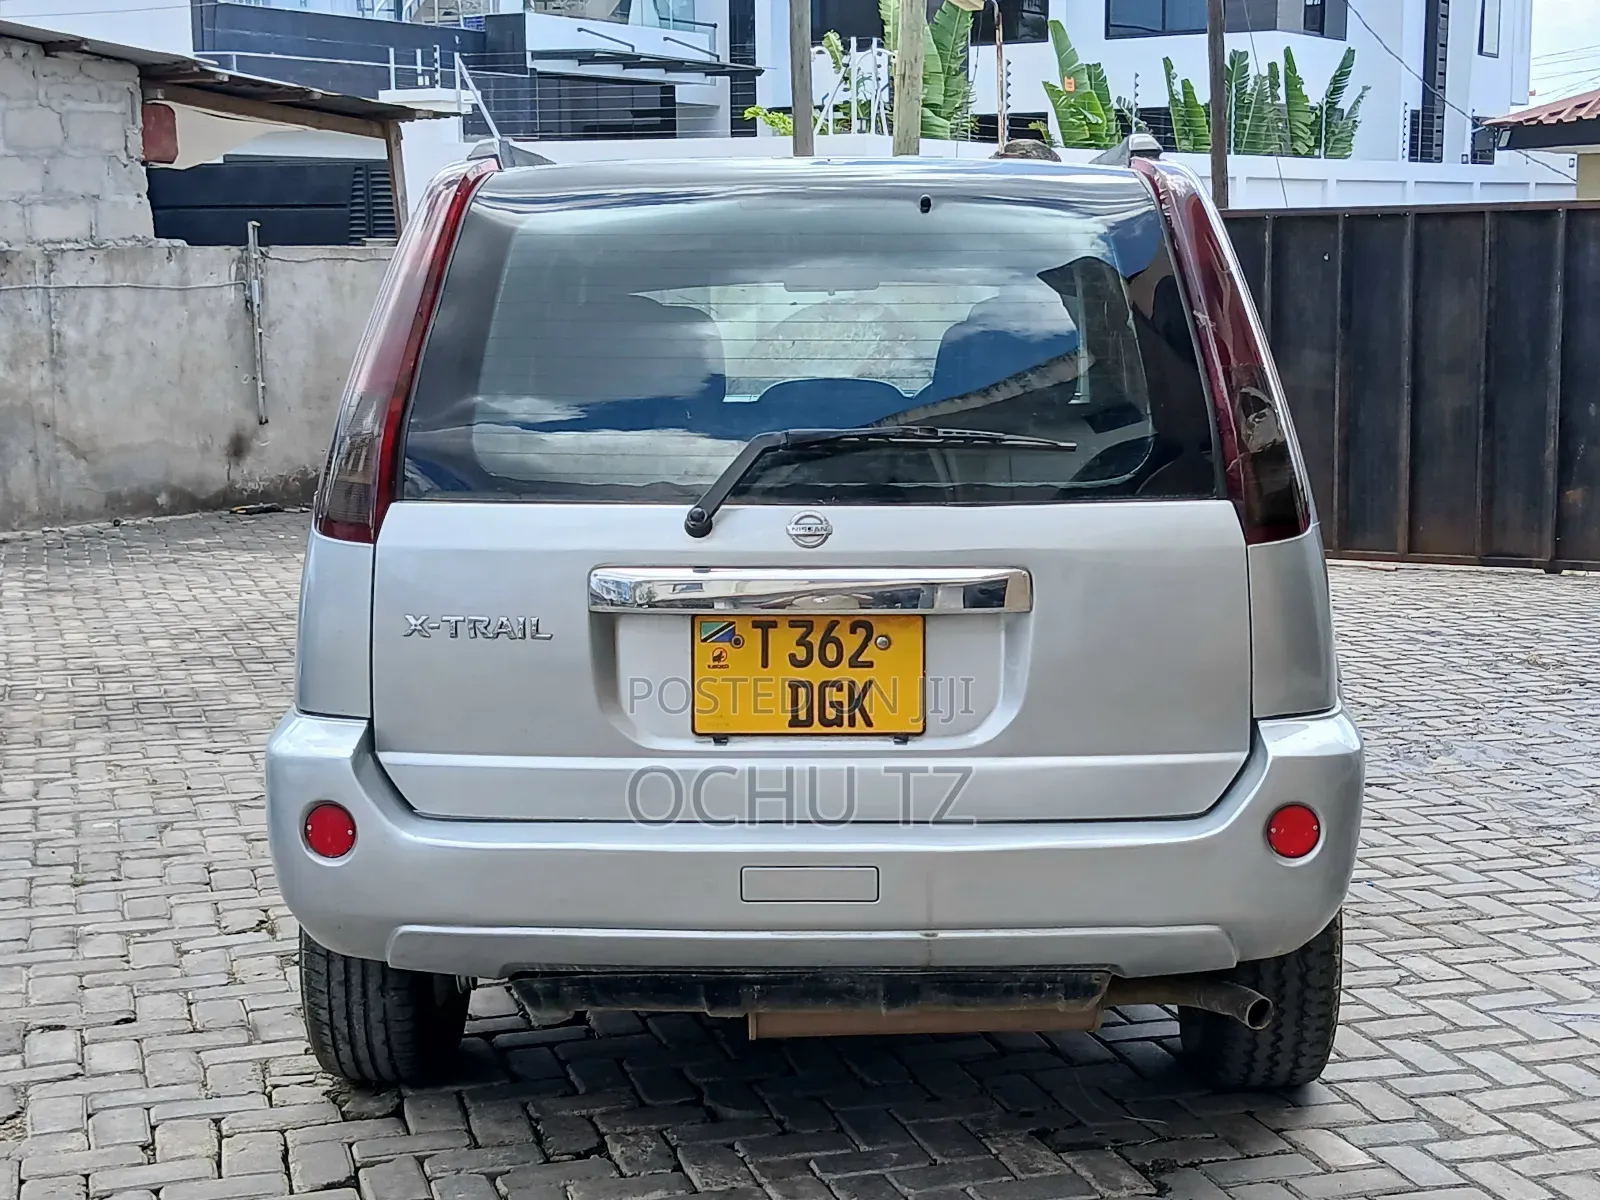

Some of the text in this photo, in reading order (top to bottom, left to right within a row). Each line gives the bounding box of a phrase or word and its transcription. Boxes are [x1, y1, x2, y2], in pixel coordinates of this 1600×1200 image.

[402, 614, 554, 640] X-TRAIL
[752, 620, 874, 669] T 362
[788, 680, 874, 728] DGK
